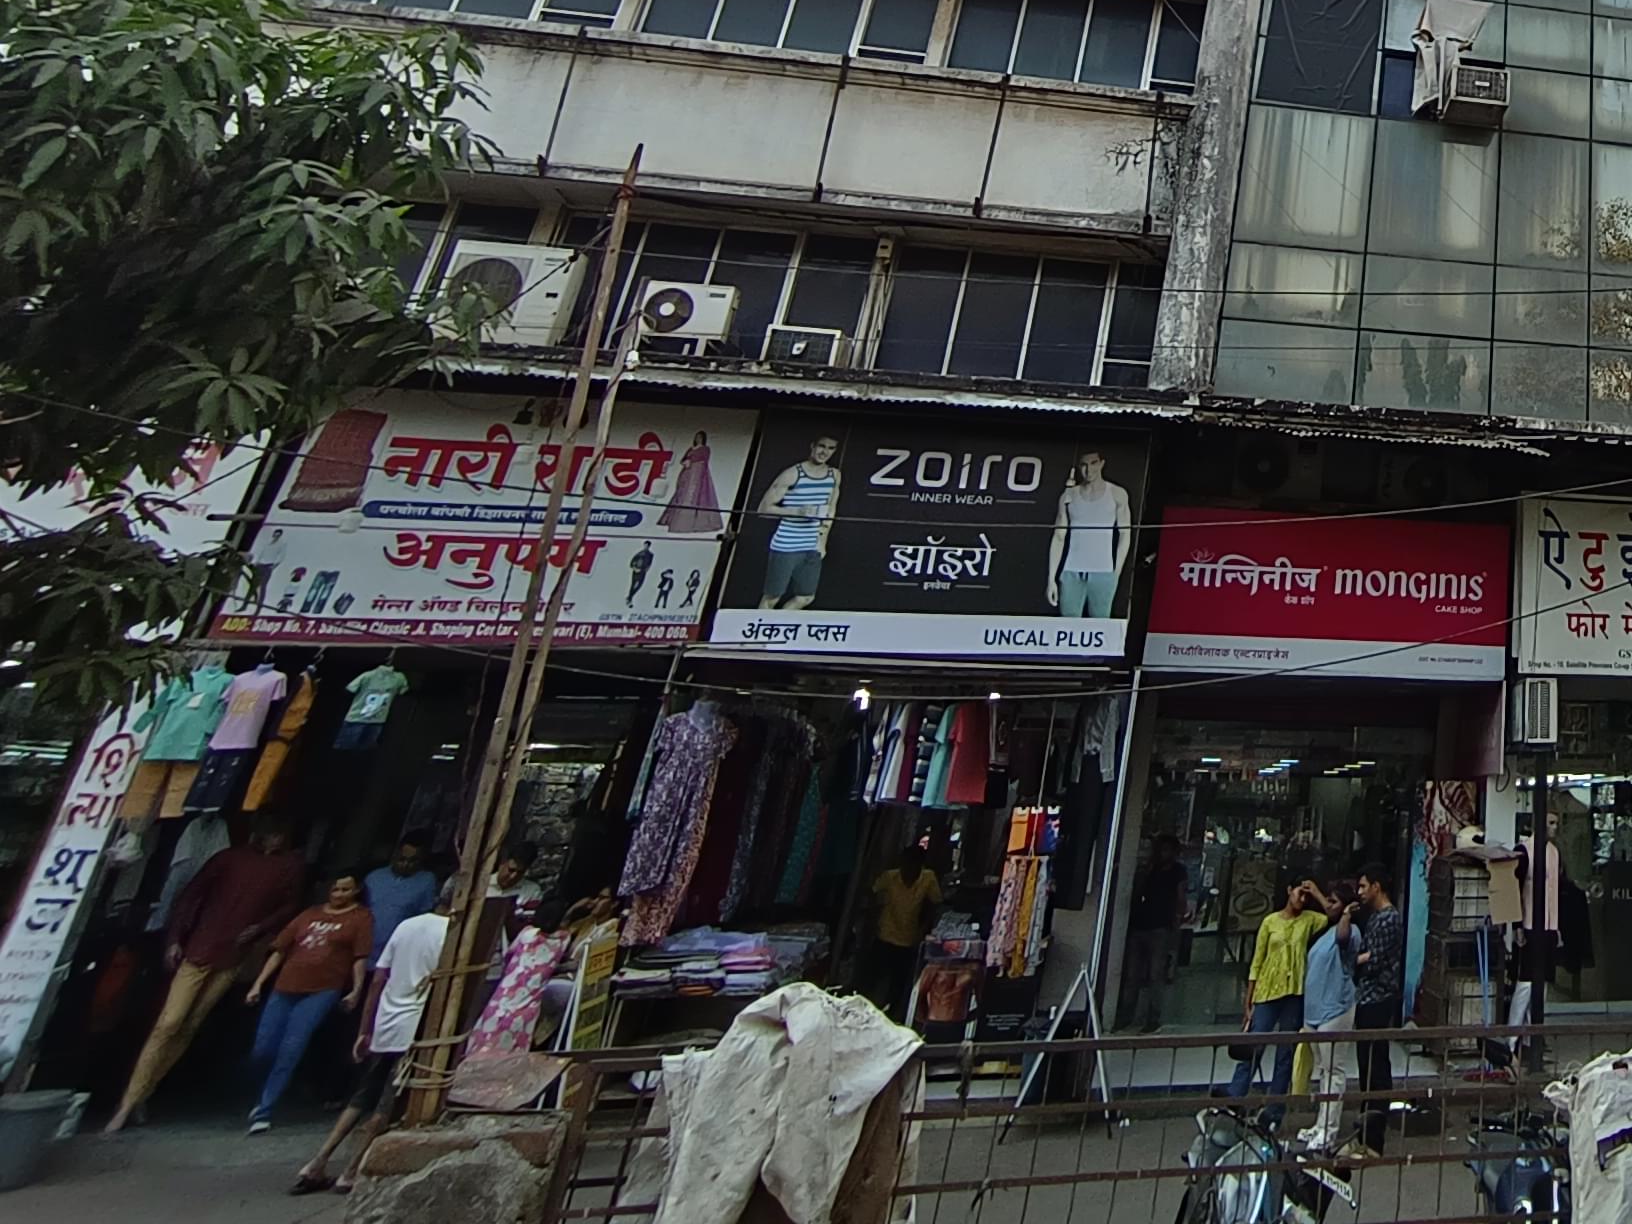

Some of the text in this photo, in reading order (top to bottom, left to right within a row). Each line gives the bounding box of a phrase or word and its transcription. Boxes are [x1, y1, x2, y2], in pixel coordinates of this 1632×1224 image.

[384, 423, 517, 492] नारी
[910, 491, 993, 506] INNER WEAR
[383, 532, 607, 589] अनुपम
[888, 533, 997, 580] झॉइरो
[1538, 508, 1572, 590] ऐ
[1578, 532, 1609, 592] टु
[1434, 605, 1483, 614] CAKE SHOP
[1566, 600, 1610, 639] फोर
[741, 618, 850, 643] अंकल प्लस
[983, 628, 1104, 648] UNCAL PLUS
